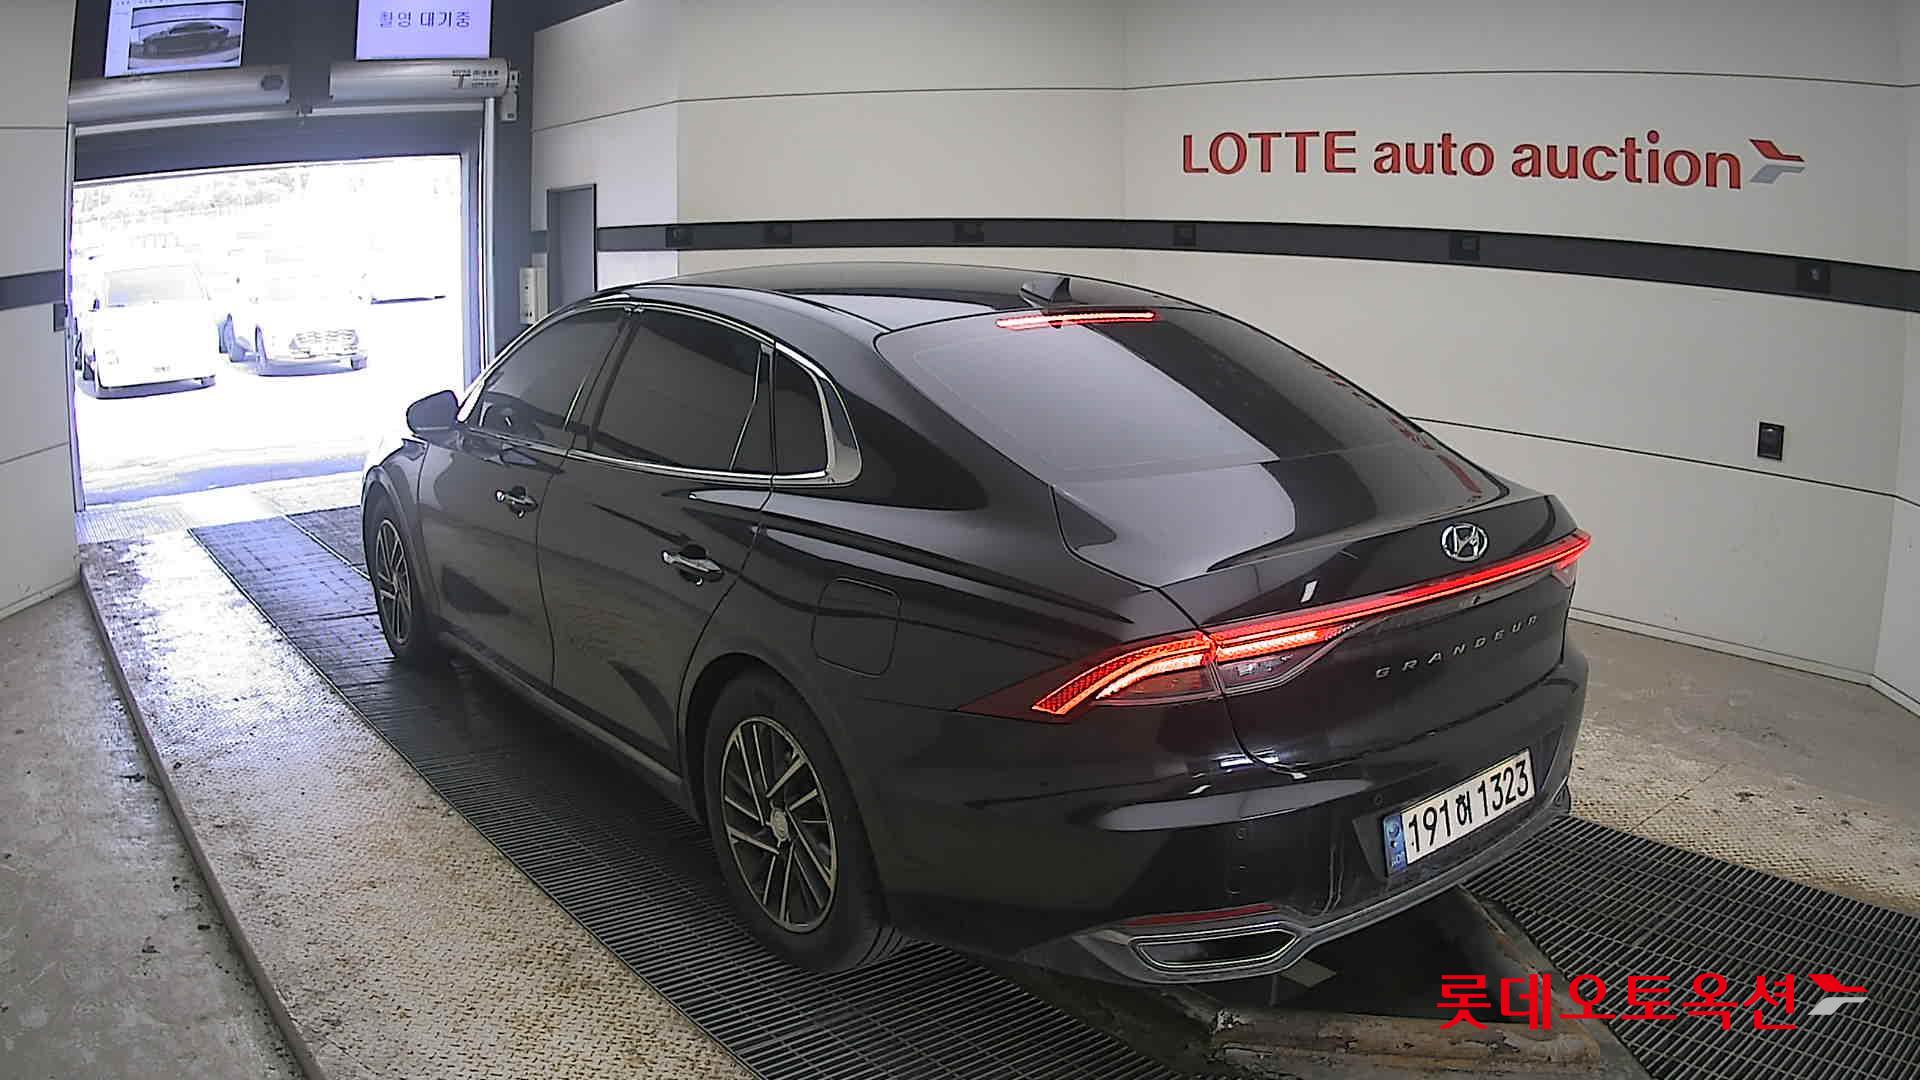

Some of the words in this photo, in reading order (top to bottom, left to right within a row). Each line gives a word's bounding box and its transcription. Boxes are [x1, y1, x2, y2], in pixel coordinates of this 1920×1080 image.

[420, 11, 471, 28] 대기중
[1183, 131, 1357, 175] LOTTE
[1374, 133, 1495, 176] auto
[1511, 130, 1742, 189] auction
[1375, 615, 1538, 678] GRANDEUR
[1408, 791, 1473, 853] 191허
[1478, 759, 1529, 817] 1323
